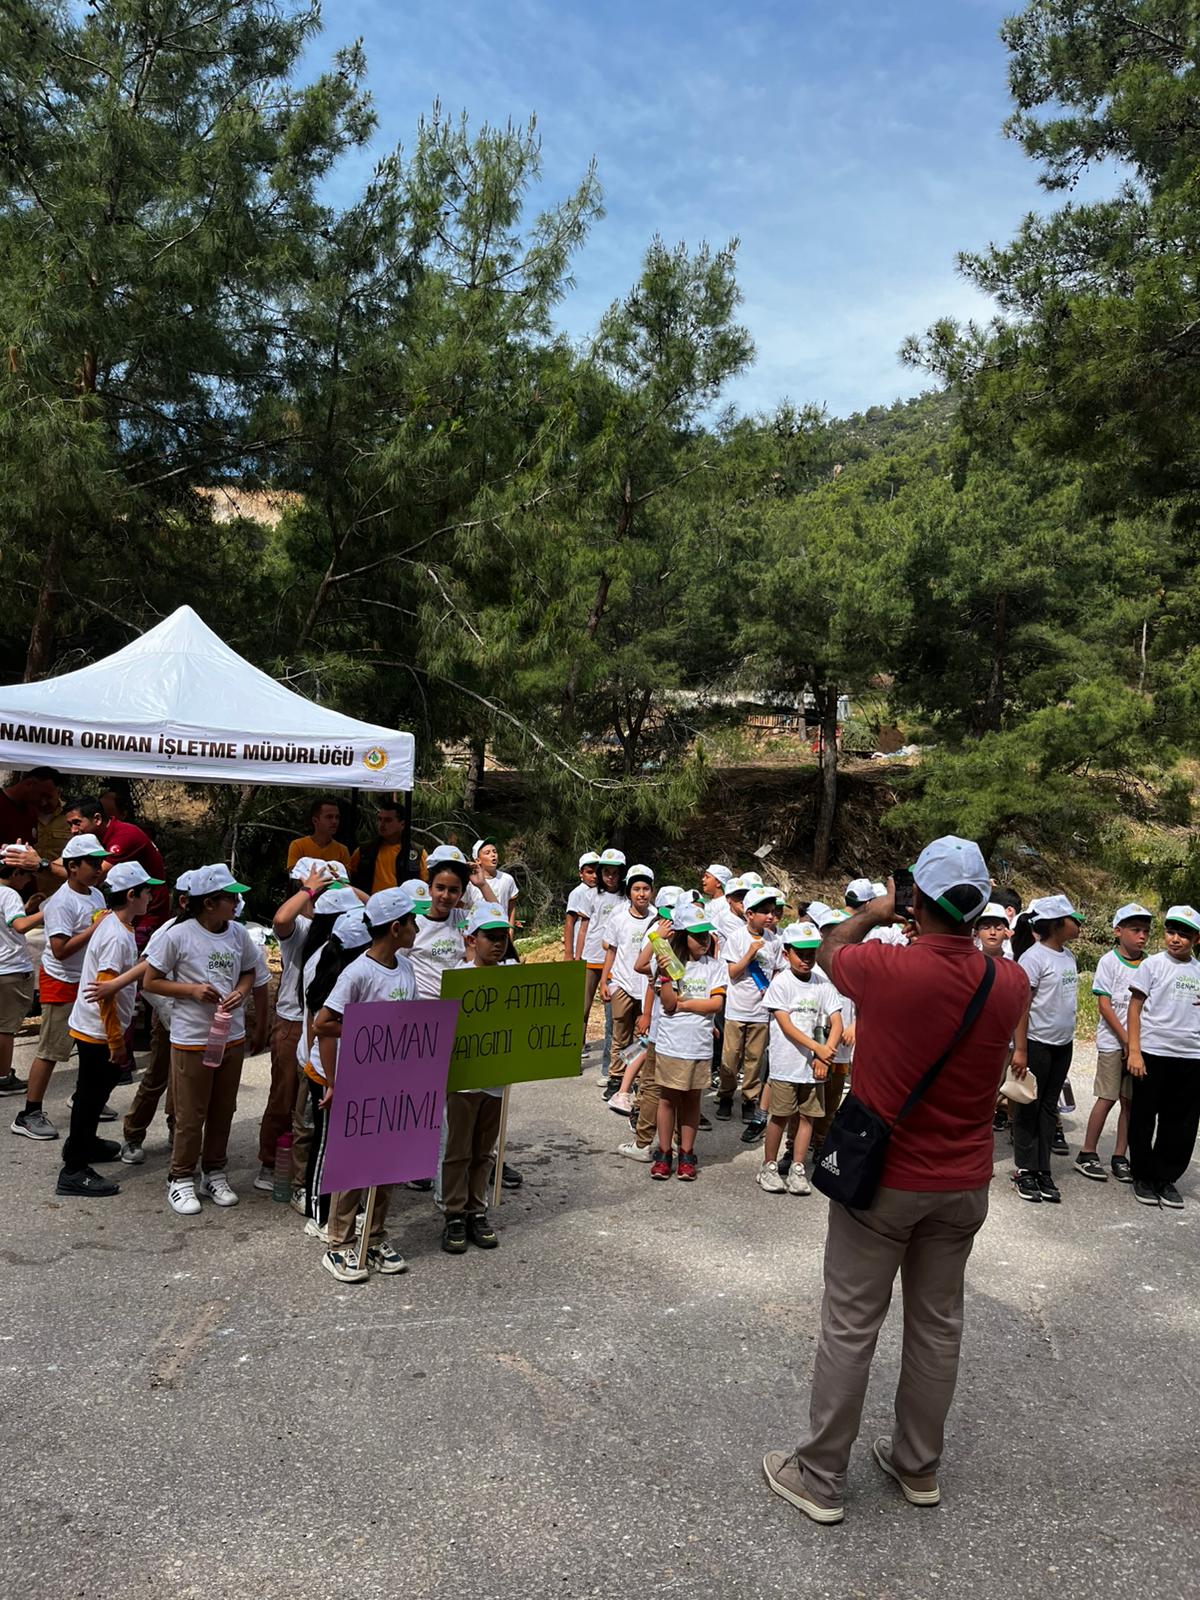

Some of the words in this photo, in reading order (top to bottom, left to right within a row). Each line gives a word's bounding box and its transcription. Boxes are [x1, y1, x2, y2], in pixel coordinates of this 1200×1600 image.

[0, 722, 74, 747] NAMUR
[80, 731, 152, 753] ORMAN
[157, 733, 238, 760] İŞLETME
[242, 741, 355, 767] MÜDÜRLÜĞÜ
[461, 984, 499, 1018] ÇÖP
[353, 1021, 440, 1065] ORMAN
[527, 1023, 578, 1050] ÖNLE.
[820, 1160, 841, 1176] adidas
